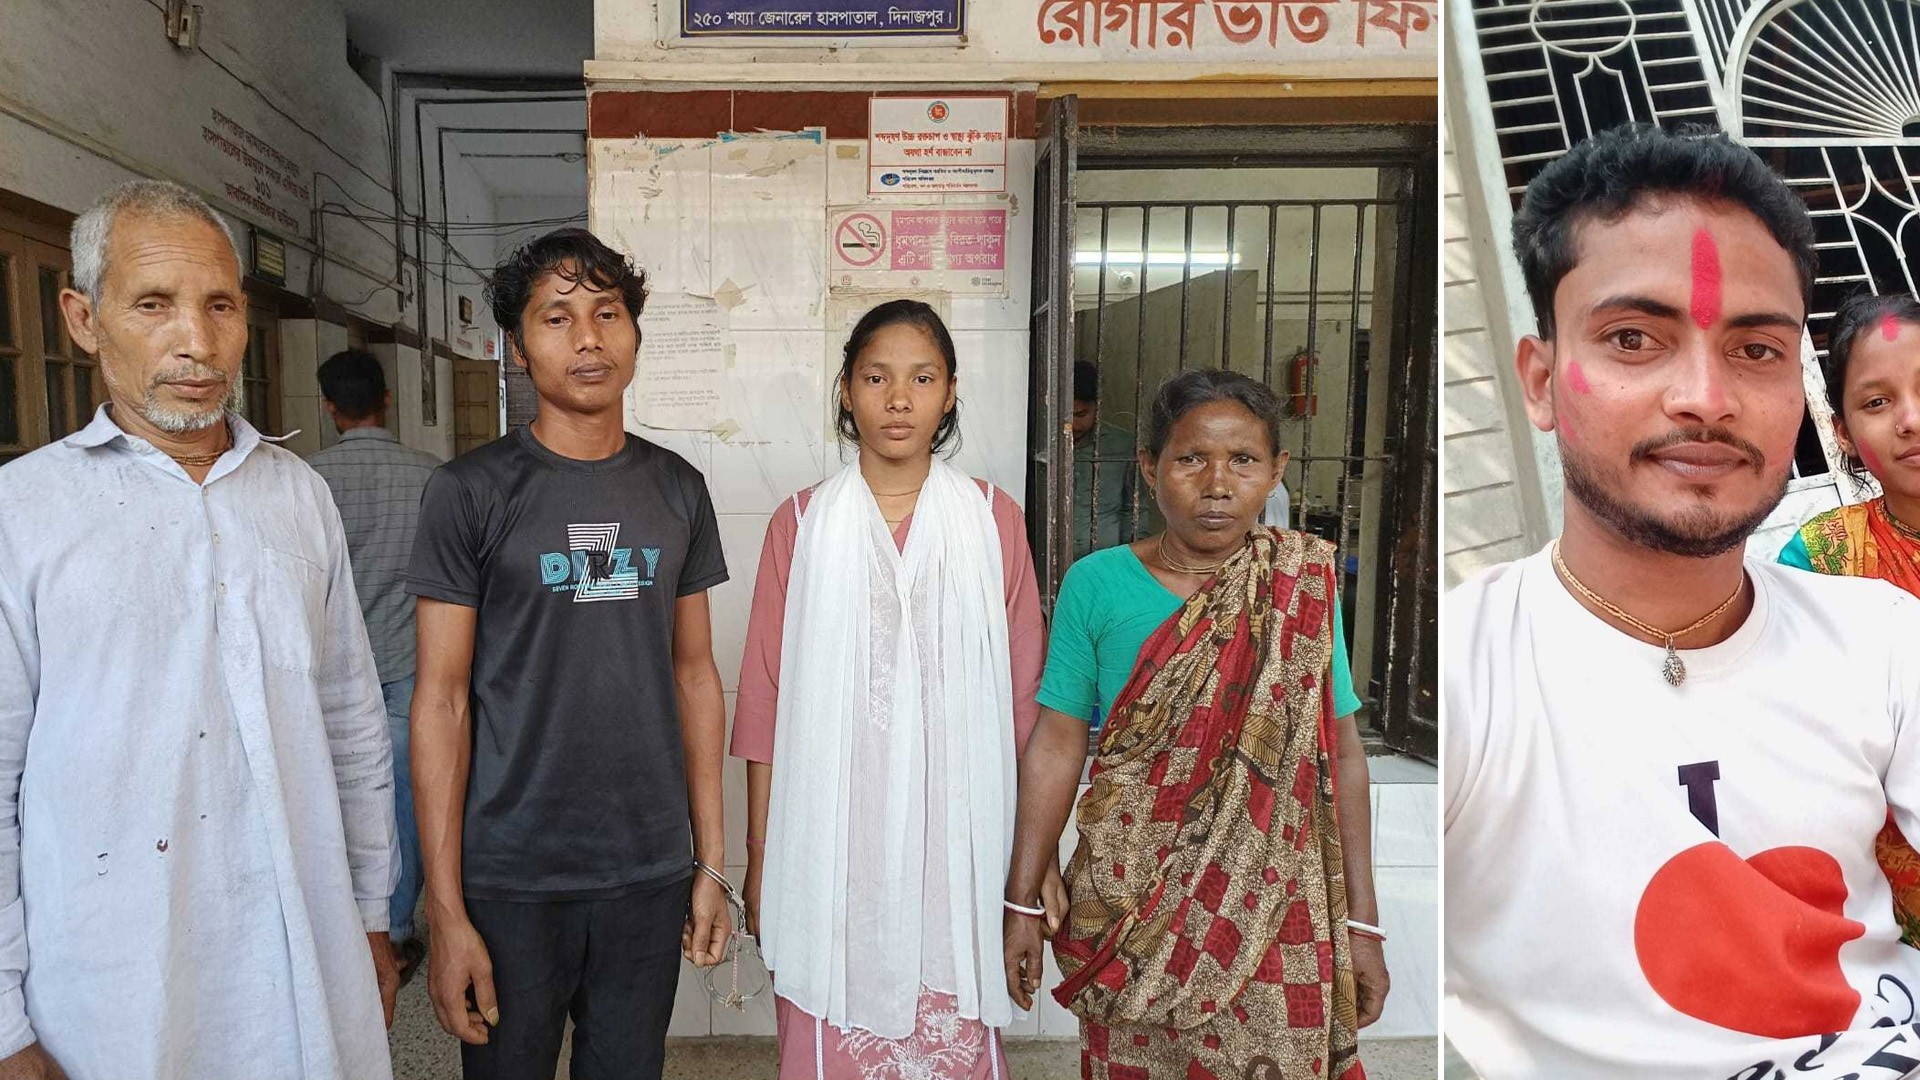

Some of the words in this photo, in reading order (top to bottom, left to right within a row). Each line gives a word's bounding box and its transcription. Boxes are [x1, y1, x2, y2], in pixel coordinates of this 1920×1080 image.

[693, 12, 721, 27] ২৫০
[726, 11, 754, 25] শয্যা
[758, 11, 812, 25] জেনারেল
[964, 148, 972, 156] না
[898, 250, 915, 265] এটি
[963, 252, 997, 266] অপরাধ
